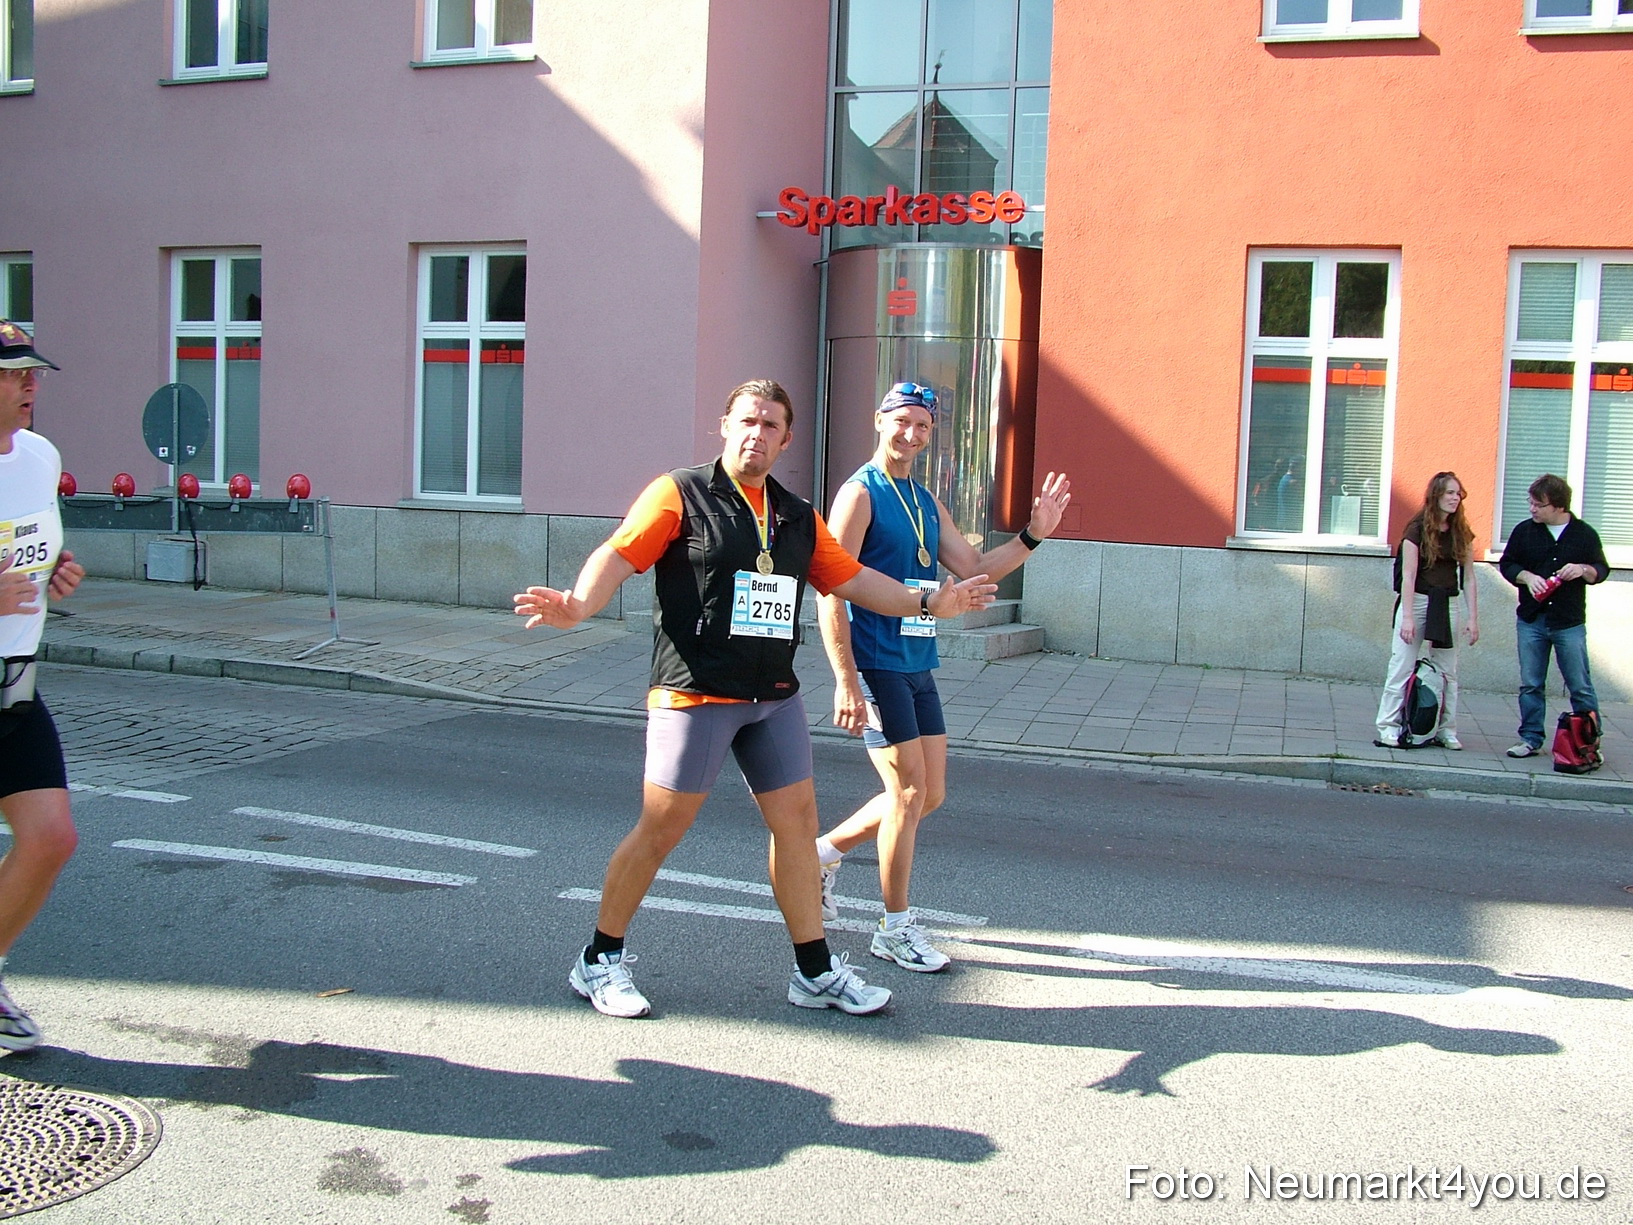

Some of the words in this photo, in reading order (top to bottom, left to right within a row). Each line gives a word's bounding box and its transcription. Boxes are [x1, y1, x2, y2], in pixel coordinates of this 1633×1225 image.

[777, 185, 1026, 236] Sparkasse
[13, 542, 48, 567] 295
[751, 580, 778, 593] Bernd
[737, 595, 746, 605] A
[752, 600, 791, 621] 2785
